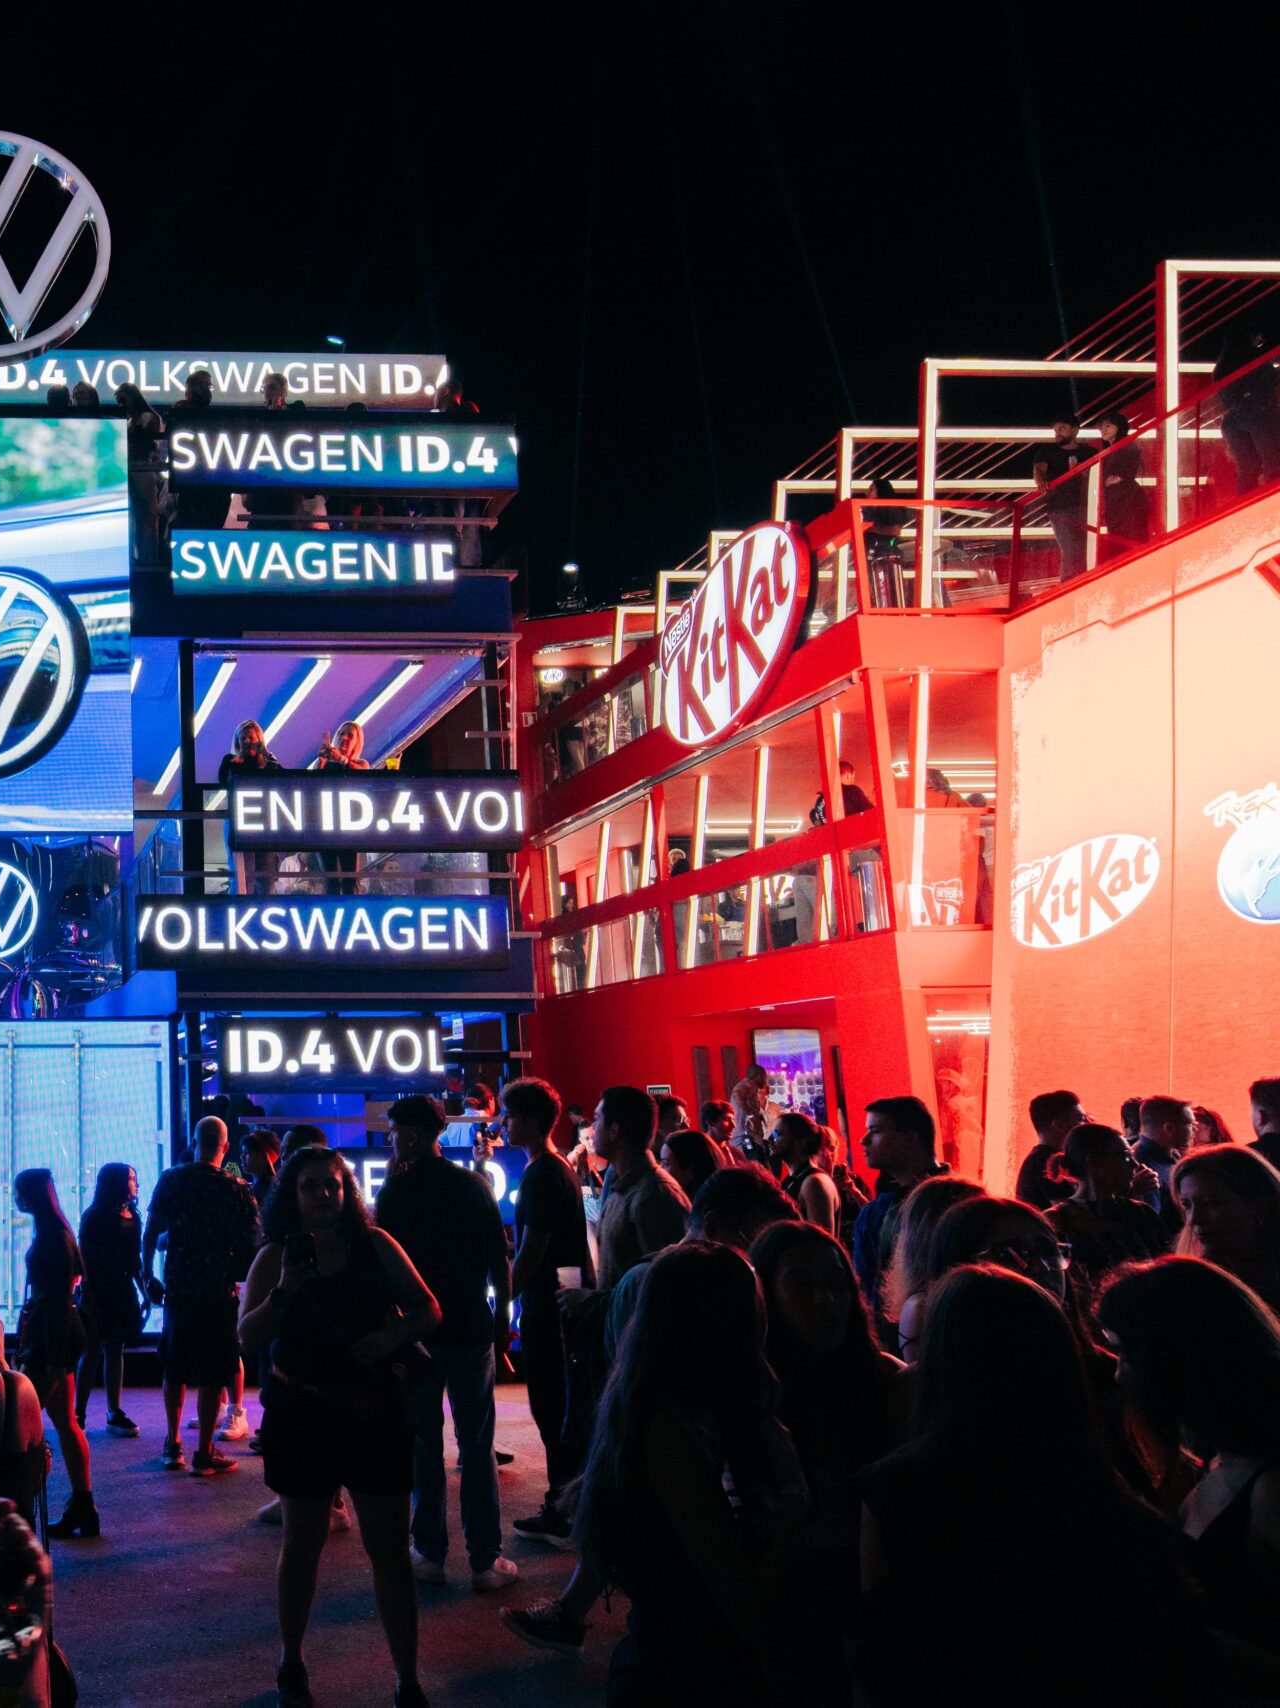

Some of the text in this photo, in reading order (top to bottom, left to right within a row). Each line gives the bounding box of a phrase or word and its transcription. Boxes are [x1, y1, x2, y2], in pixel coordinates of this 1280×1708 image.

[171, 431, 384, 472] SWAGEN
[399, 434, 499, 473] ID.4
[170, 540, 398, 582] SWAGEN
[677, 533, 790, 741] KitKat
[236, 790, 304, 832] EN
[320, 790, 425, 832] ID.4
[1023, 837, 1152, 946] KitKat
[228, 1028, 336, 1074] ID.4
